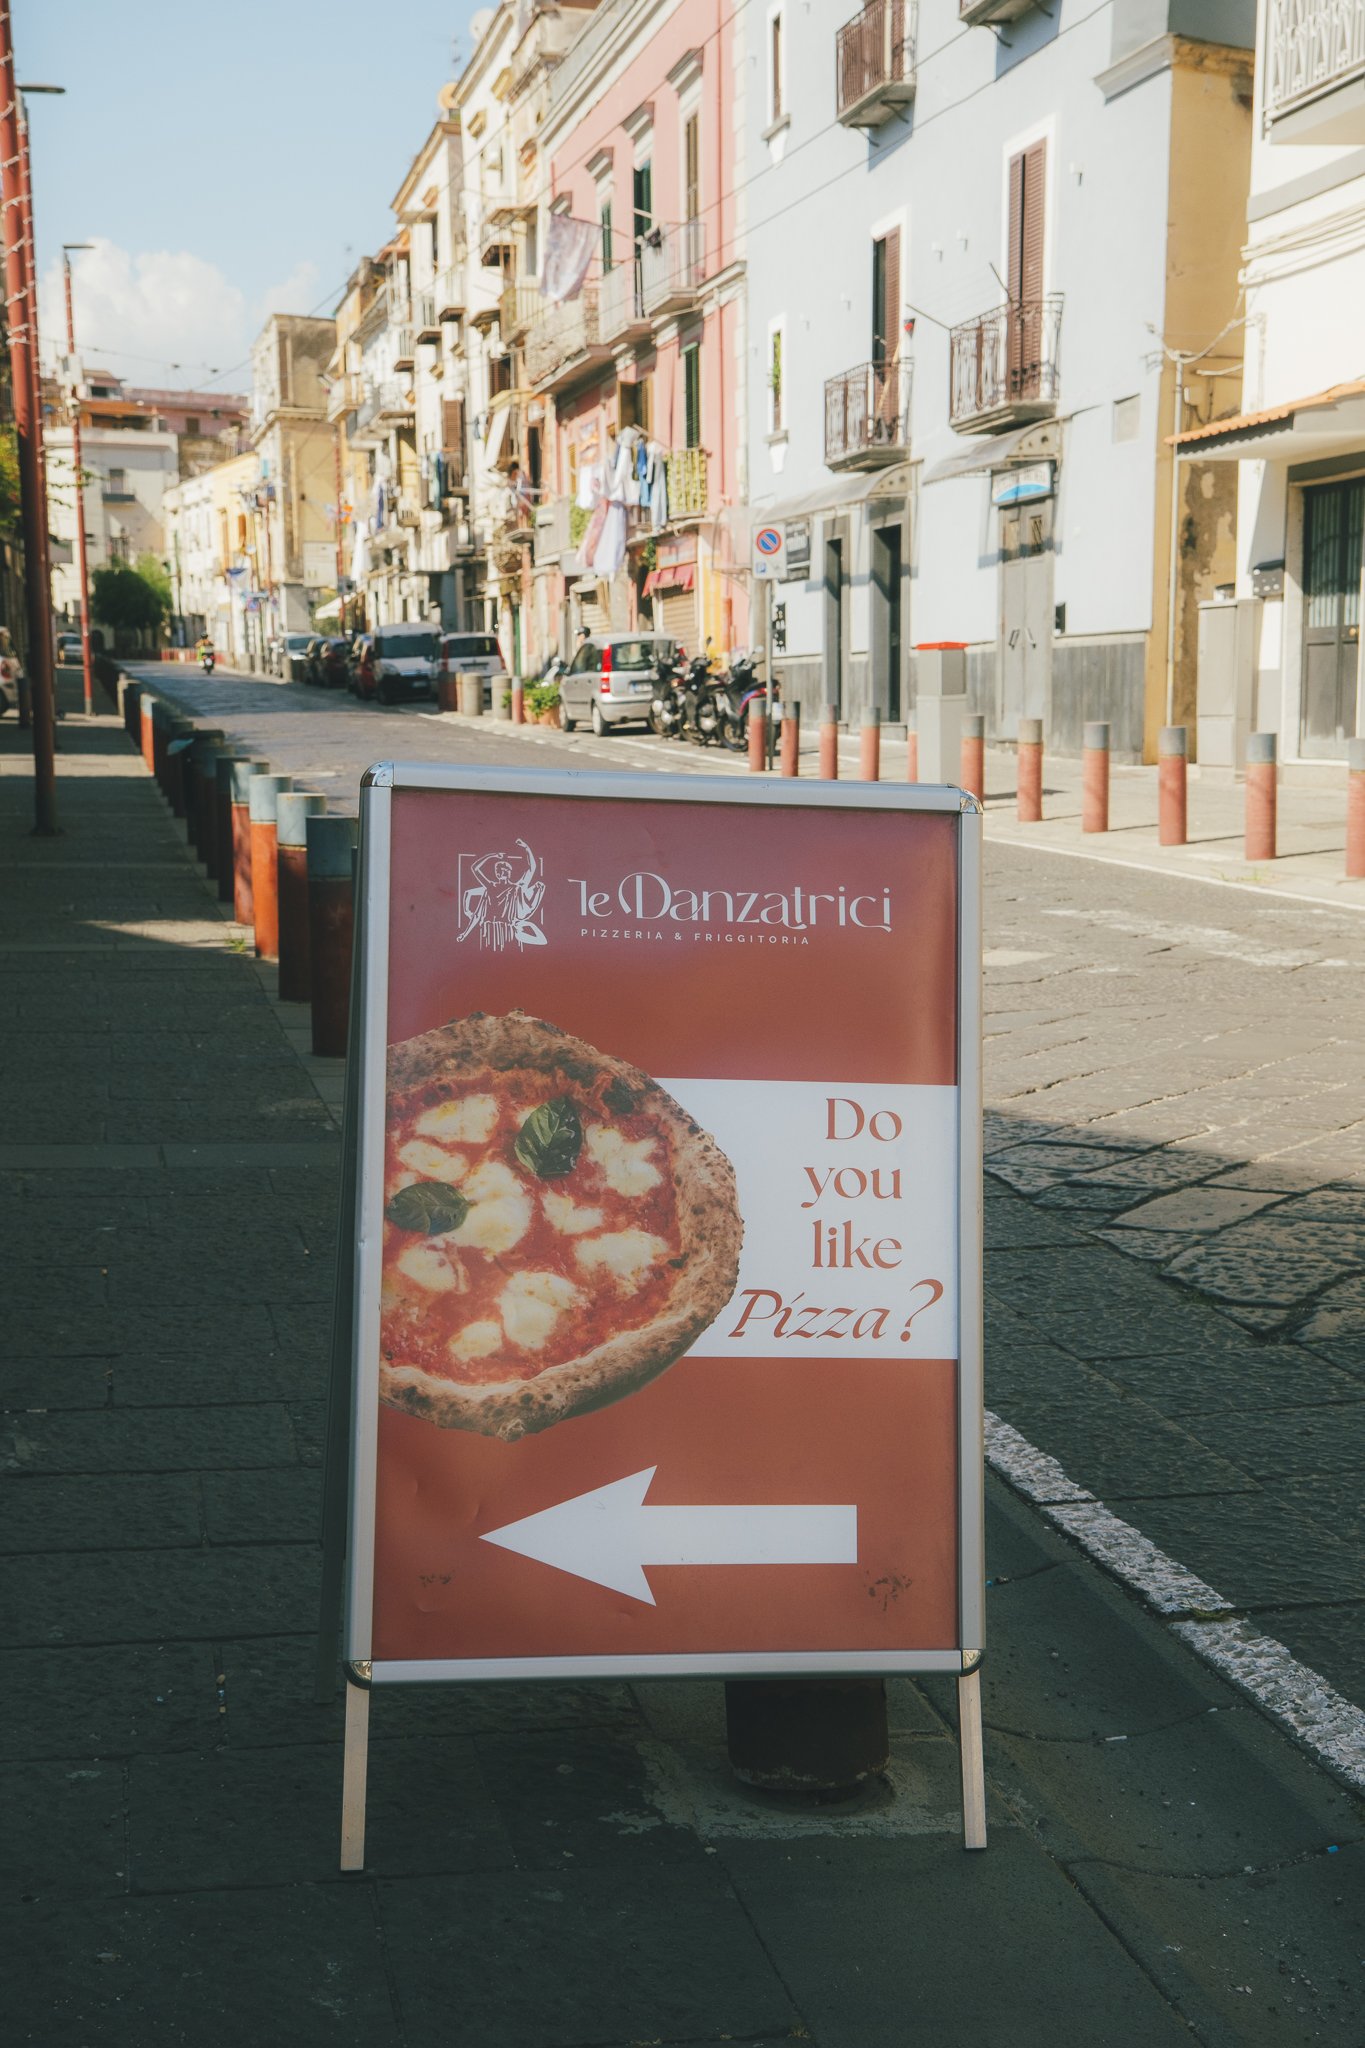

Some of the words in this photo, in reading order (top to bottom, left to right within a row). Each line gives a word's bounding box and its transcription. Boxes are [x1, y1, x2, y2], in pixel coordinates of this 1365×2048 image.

[567, 878, 613, 918] le
[618, 871, 892, 933] Danzatrici
[580, 928, 663, 940] PIZZERIA
[674, 931, 682, 941] &
[694, 932, 809, 945] FRIGGITORIA
[825, 1097, 903, 1142] Do
[800, 1166, 903, 1209] you
[811, 1219, 903, 1270] like
[727, 1277, 945, 1343] Pizza?
